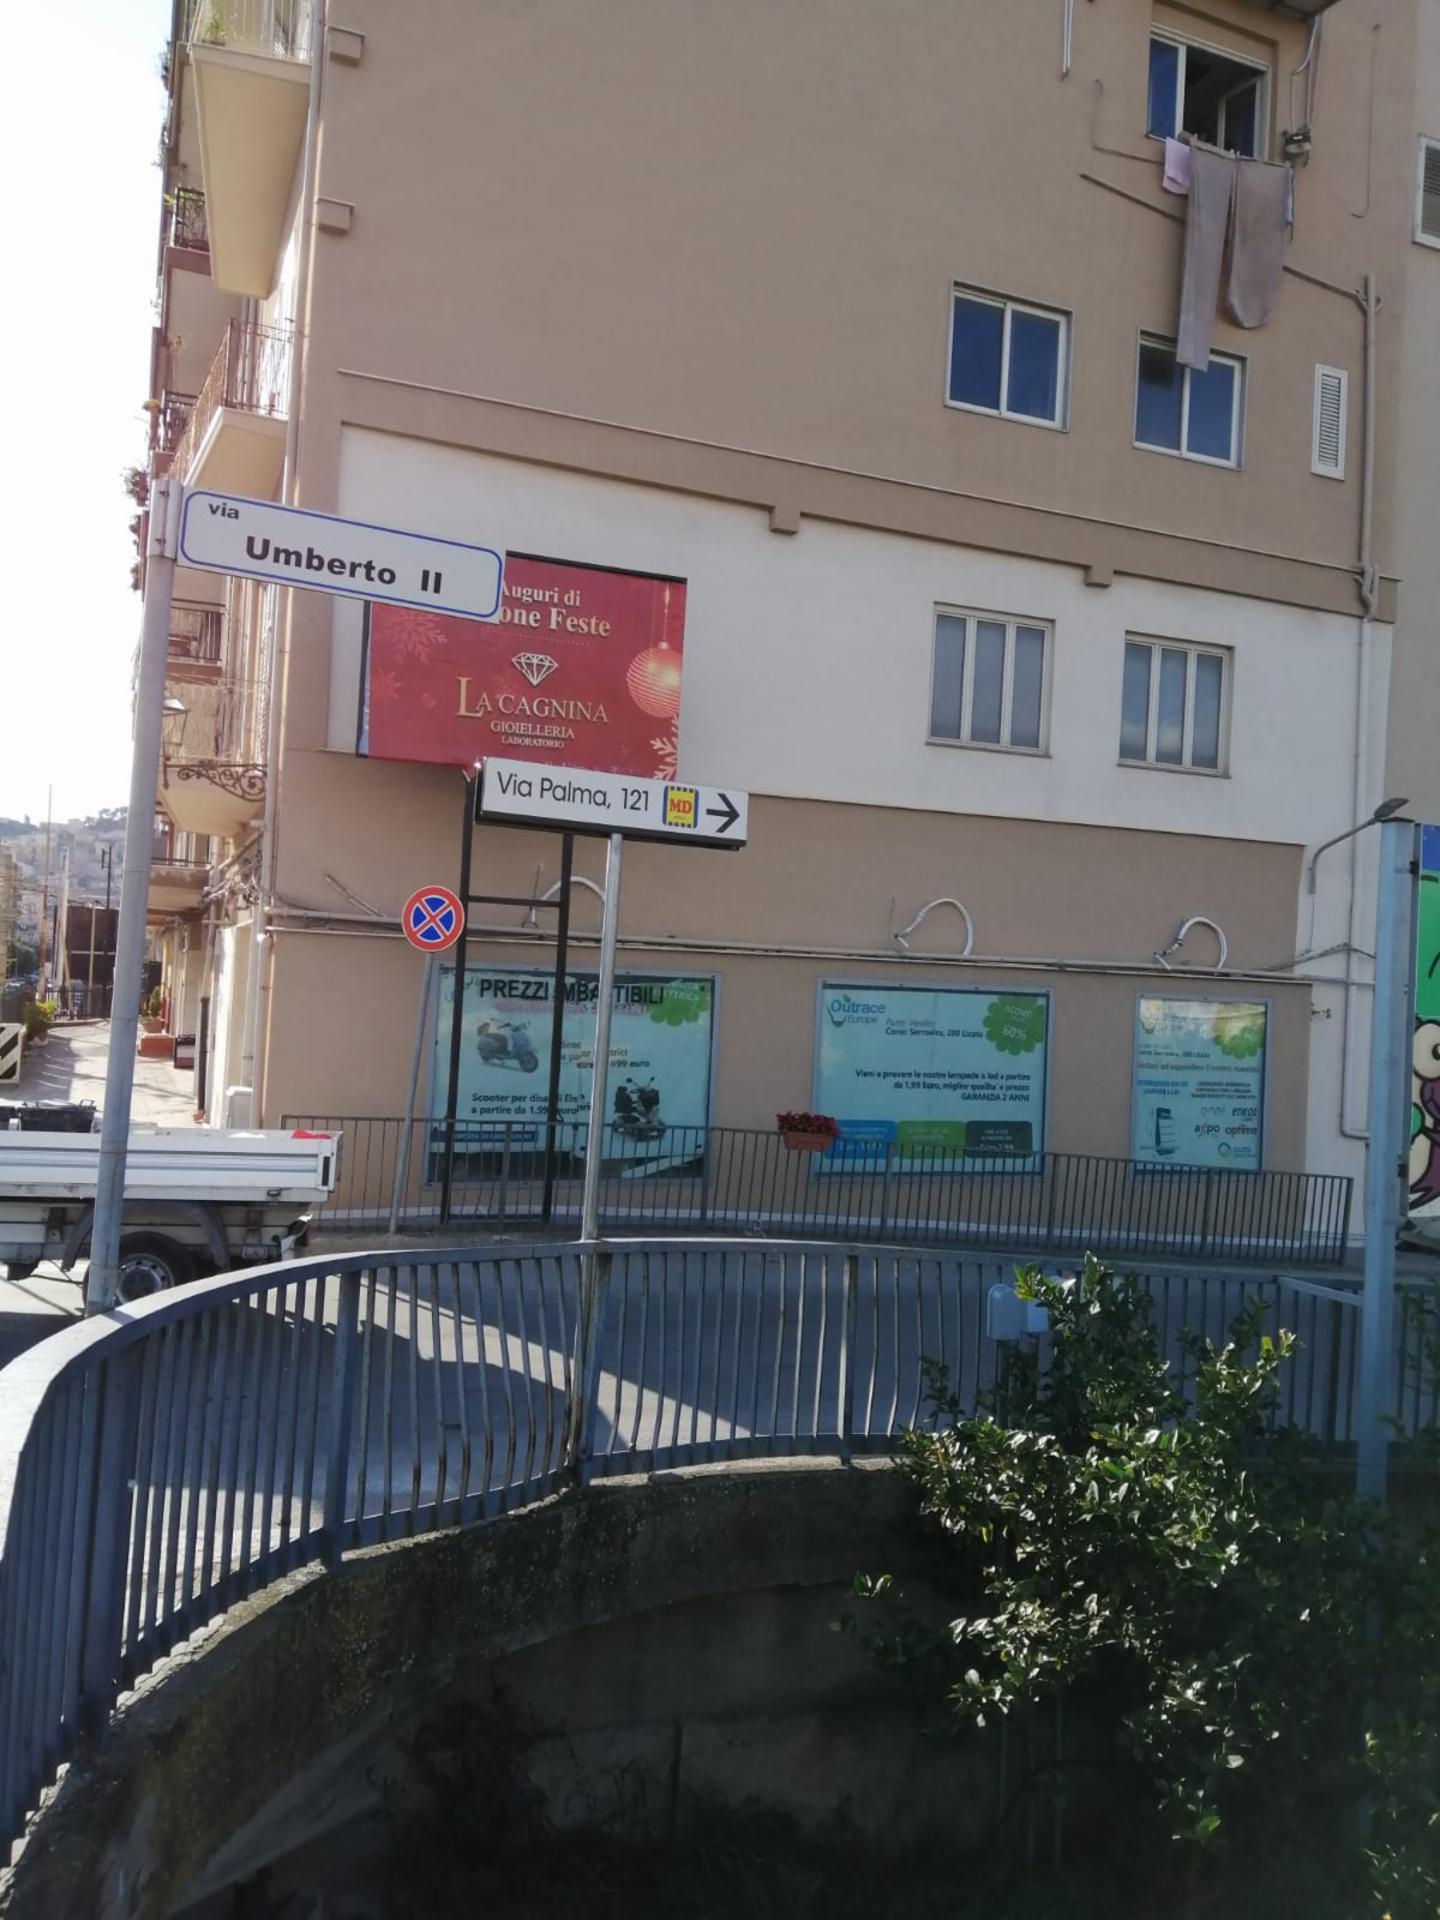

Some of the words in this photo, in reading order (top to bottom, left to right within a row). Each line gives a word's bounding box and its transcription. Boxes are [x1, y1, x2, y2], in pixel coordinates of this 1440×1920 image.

[208, 502, 240, 520] via
[245, 535, 396, 585] Umberto
[420, 569, 442, 594] II
[564, 589, 581, 607] di
[500, 606, 541, 628] one
[549, 607, 611, 637] Feste
[498, 694, 609, 722] CAGNINA
[490, 720, 576, 739] GIOIELLERIA
[502, 735, 565, 749] LABORATORIO
[497, 771, 533, 798] Via
[540, 777, 612, 810] Palma,
[621, 787, 650, 812] 121
[670, 798, 692, 814] MD
[479, 978, 549, 1000] PREZZI
[562, 983, 663, 1004] MBATIBILI
[831, 999, 886, 1014] Outrace
[1003, 1025, 1026, 1041] 60%
[856, 1069, 875, 1077] Vieni
[883, 1071, 912, 1079] provare
[1005, 1073, 1030, 1081] partire
[943, 1082, 969, 1091] miglior
[472, 1093, 509, 1103] Scooter
[511, 1094, 527, 1104] per
[961, 1092, 1000, 1101] GARANZIA
[1009, 1094, 1029, 1102] ANNI
[479, 1106, 512, 1116] partire
[514, 1106, 526, 1114] da
